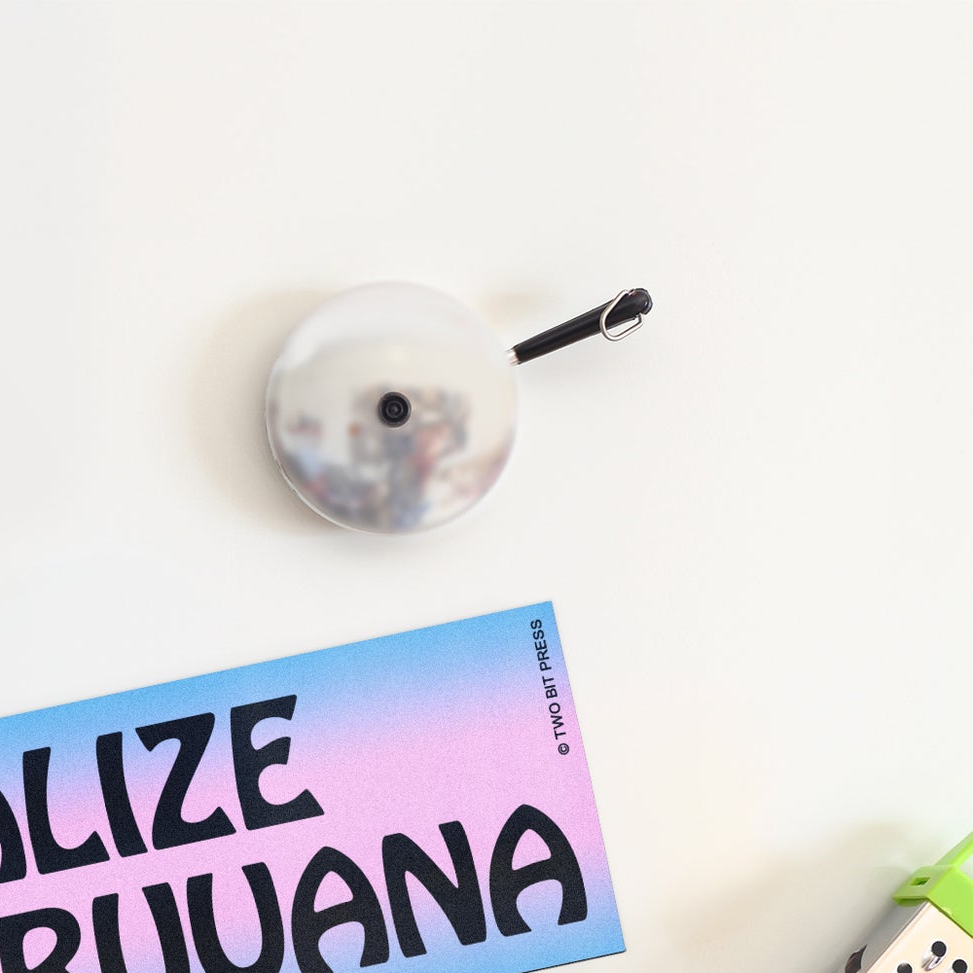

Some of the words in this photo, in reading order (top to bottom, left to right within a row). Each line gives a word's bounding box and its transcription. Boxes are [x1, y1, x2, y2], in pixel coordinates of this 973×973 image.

[530, 619, 552, 672] PRESS
[542, 676, 558, 699] BIT
[548, 702, 566, 740] TWO
